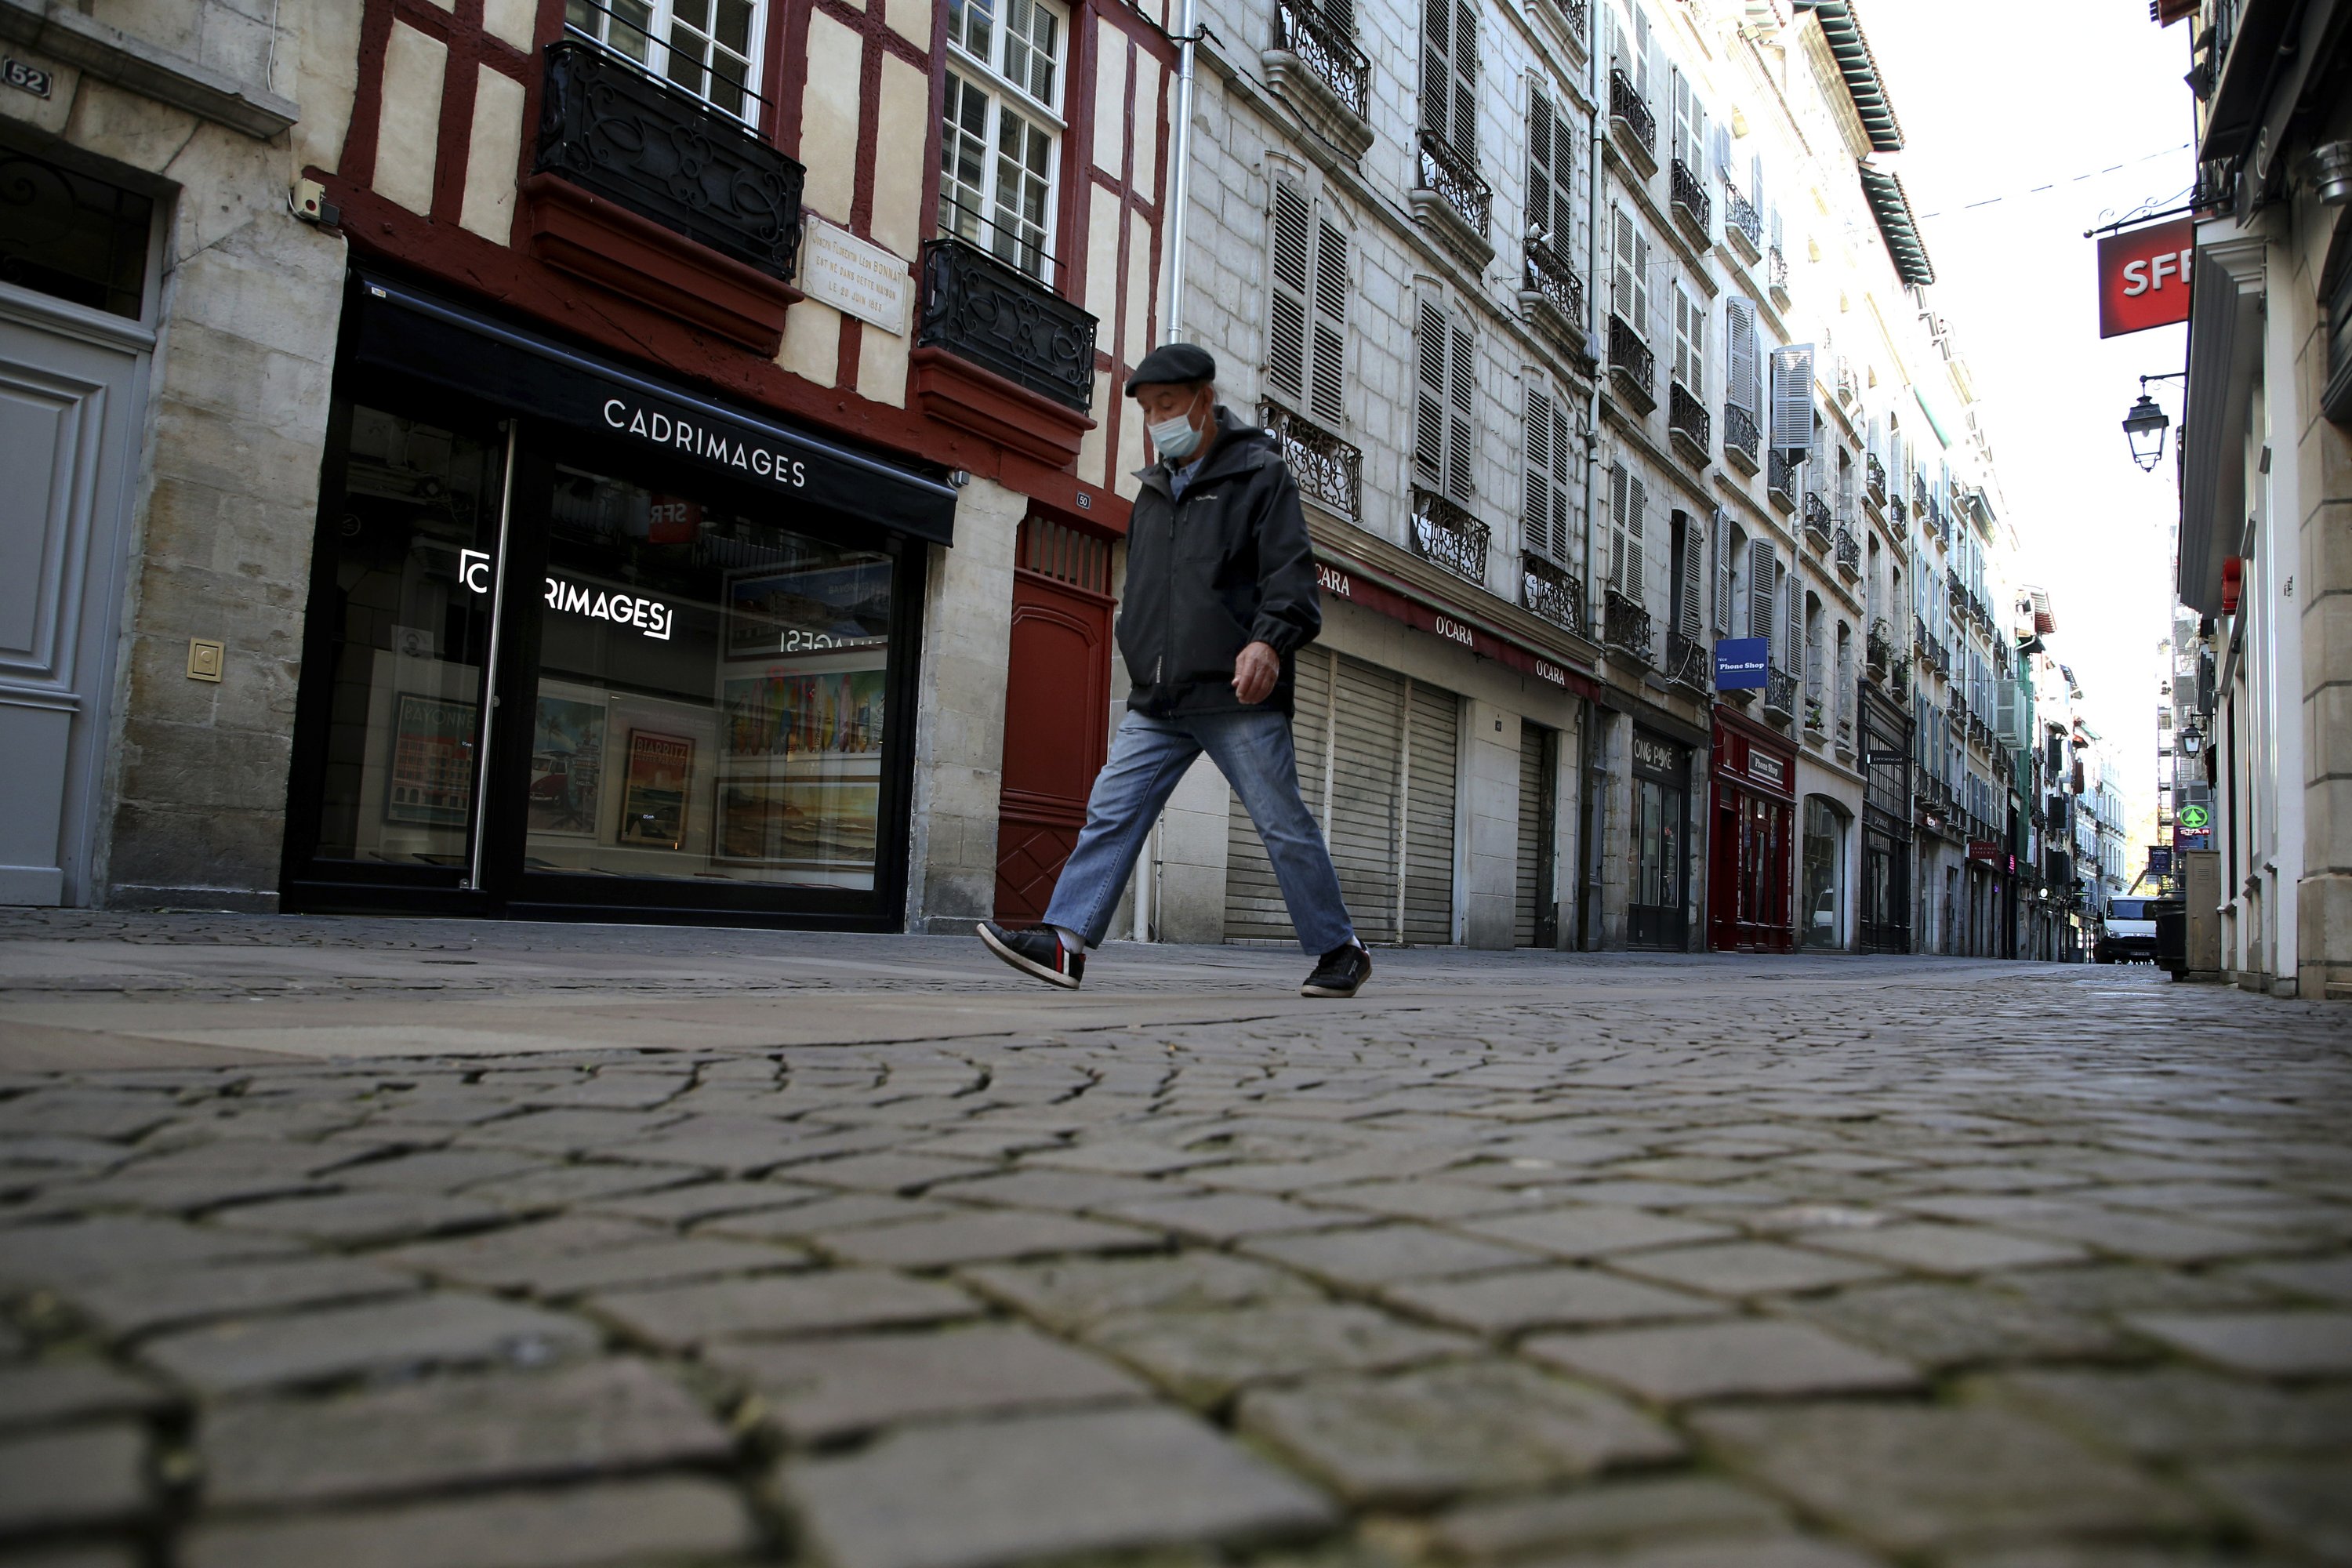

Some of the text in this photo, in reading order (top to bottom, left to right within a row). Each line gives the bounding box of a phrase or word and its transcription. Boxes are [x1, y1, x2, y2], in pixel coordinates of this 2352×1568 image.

[11, 64, 43, 92] 52
[816, 256, 828, 267] EST
[840, 267, 855, 281] DANS
[856, 274, 874, 291] CETTE
[876, 284, 896, 301] MAISON
[873, 260, 902, 284] BONNAT
[829, 281, 837, 292] LE
[851, 292, 866, 306] JUIN
[604, 399, 805, 488] CADRIMAGES
[1079, 495, 1087, 506] 50
[1436, 615, 1473, 647] O'CARA
[1536, 659, 1565, 686] O'CARA
[404, 706, 474, 729] BAYONNE
[637, 739, 686, 759] BIARRITZ
[1755, 757, 1778, 777] Phone Shop
